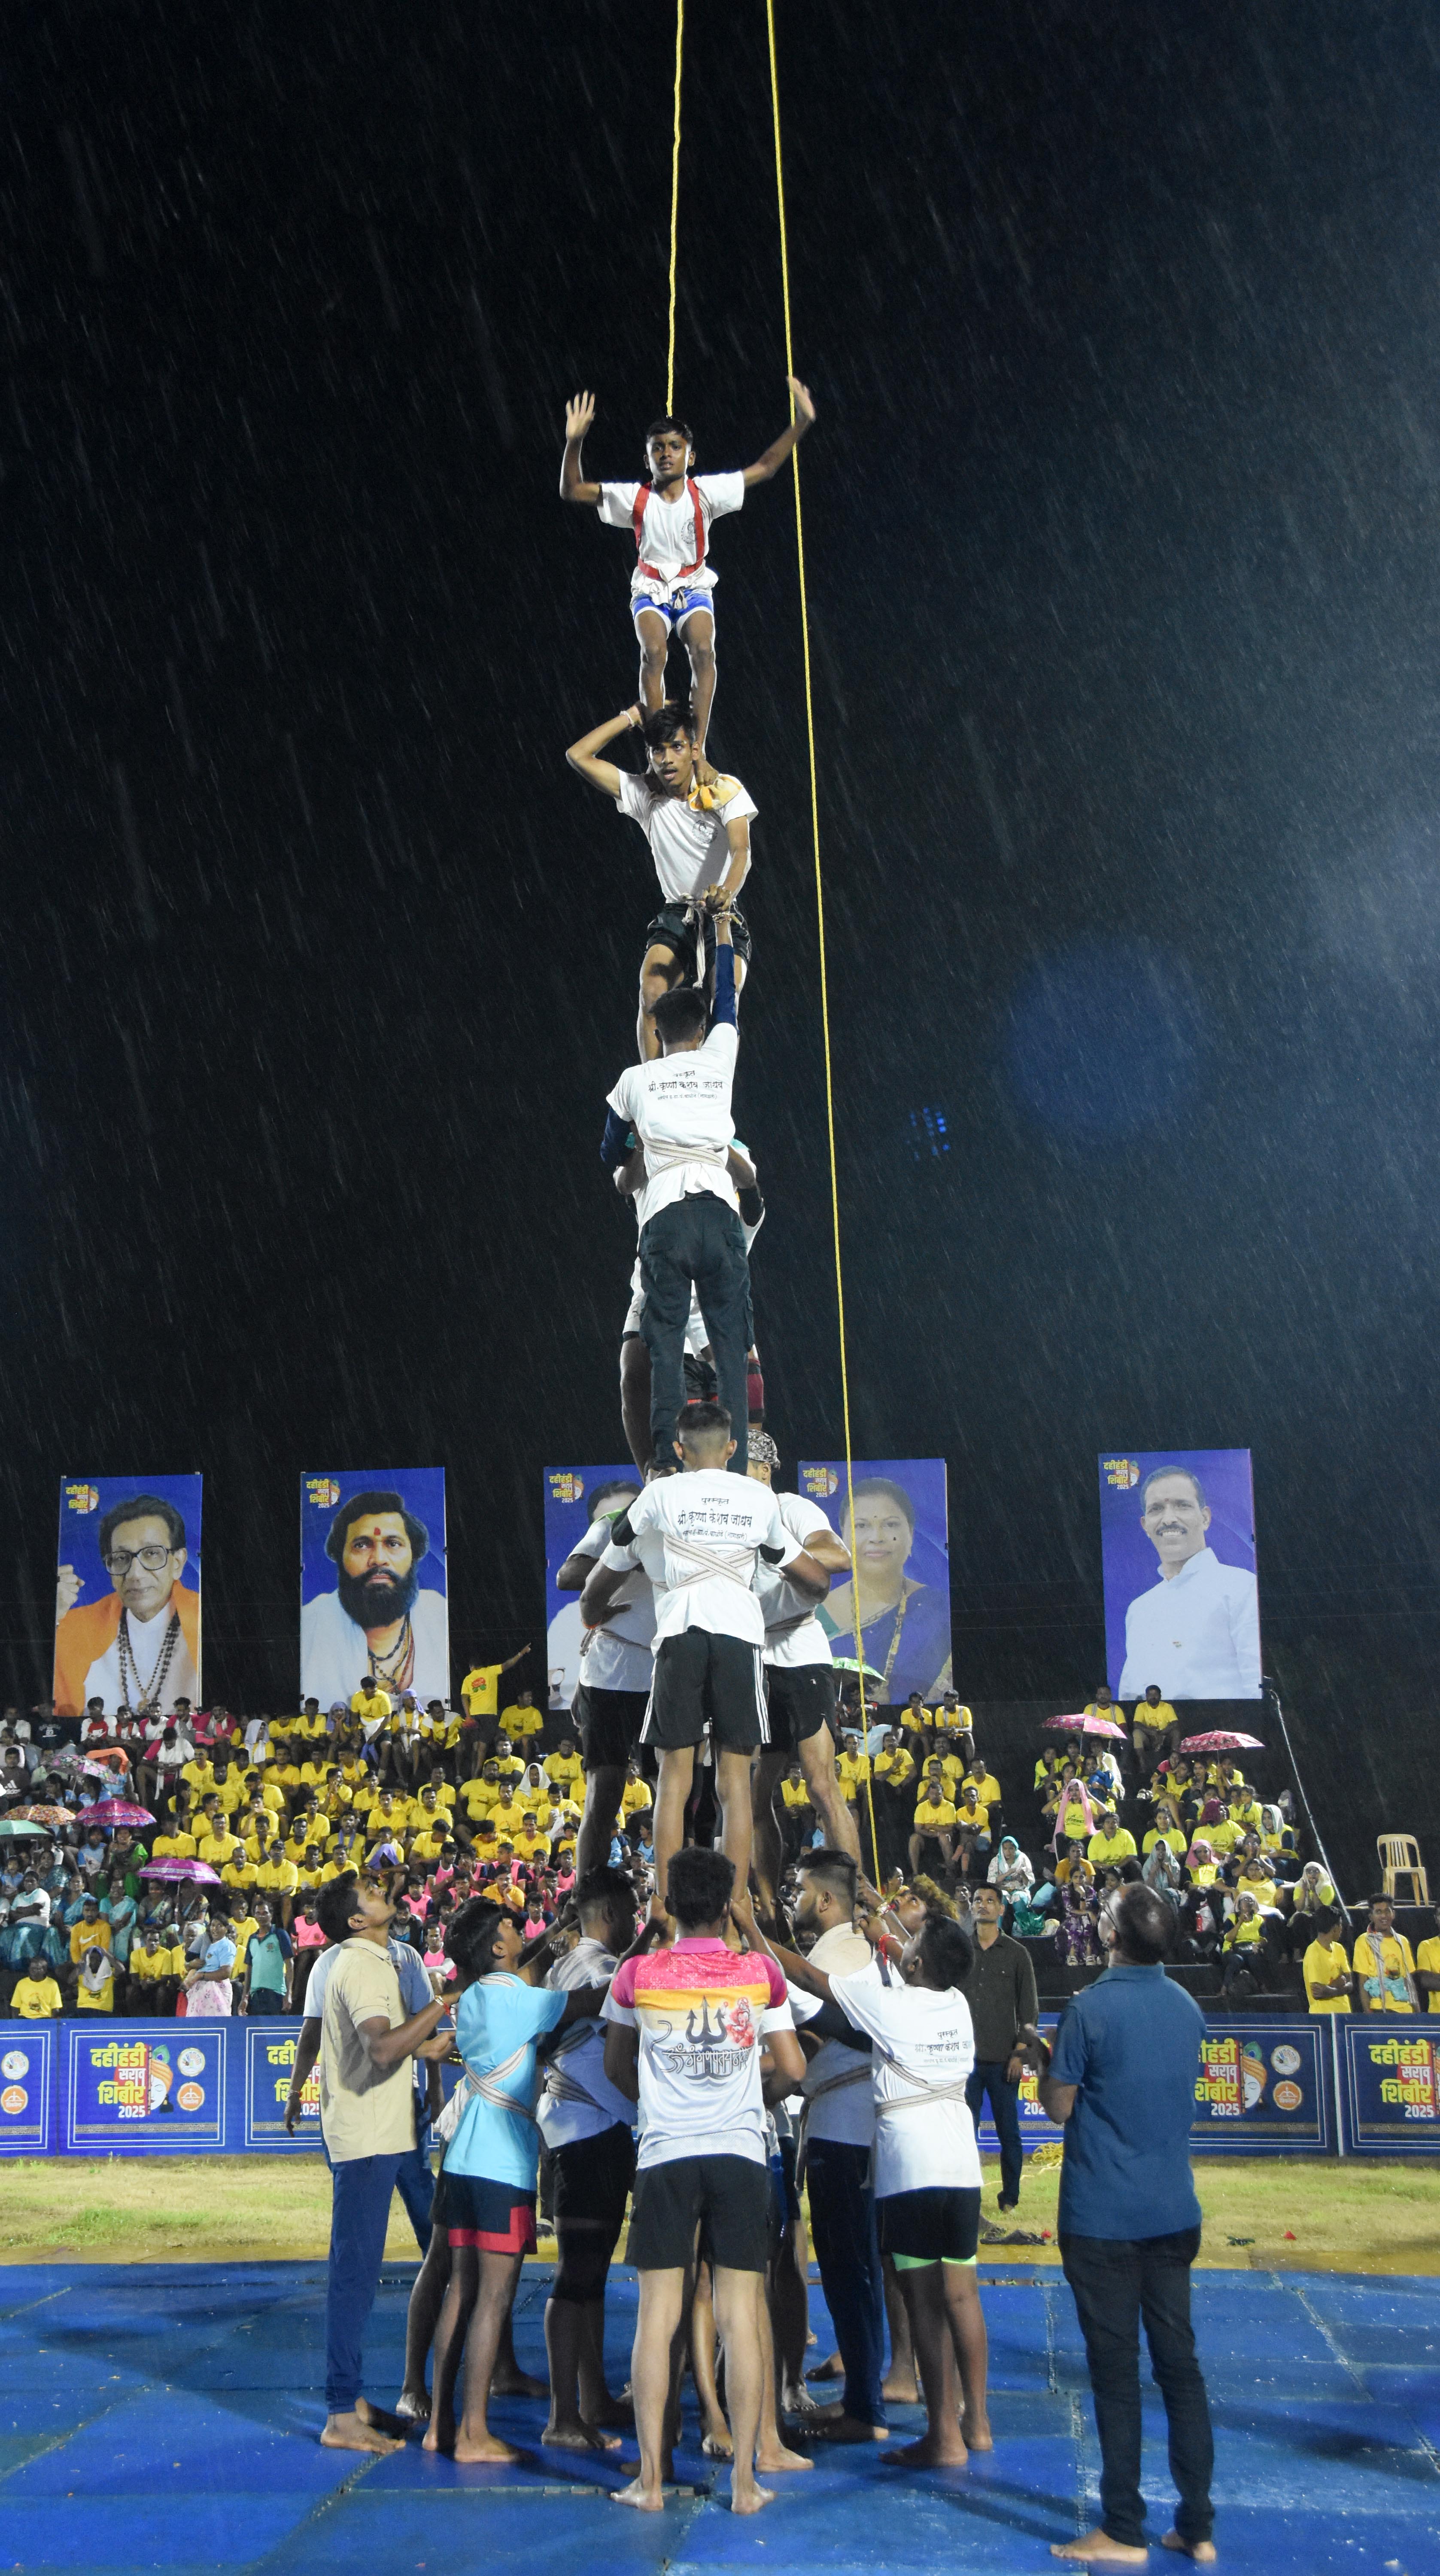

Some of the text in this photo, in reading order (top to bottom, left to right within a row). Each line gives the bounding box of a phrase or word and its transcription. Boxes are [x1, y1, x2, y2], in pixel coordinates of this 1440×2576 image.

[1103, 1459, 1127, 1470] दहीहंडी
[549, 1473, 572, 1483] दहीहंडी
[803, 1467, 826, 1477] दहीहंडी
[306, 1479, 329, 1488] दहीहंडी
[1107, 1475, 1128, 1484] शिबीर
[709, 1508, 729, 1525] केशव
[731, 1515, 752, 1527] जाधव
[937, 2029, 958, 2040] पुरस्कृत
[945, 2040, 959, 2051] केशव
[1368, 2039, 1429, 2064] दहीहंडी
[90, 2042, 146, 2067] दहीहंडी
[118, 2068, 146, 2086] सराव
[1208, 2065, 1237, 2083] सराव
[1401, 2066, 1431, 2085] सराव
[97, 2081, 146, 2104] शिबीर
[1379, 2078, 1432, 2102] शिबीर
[118, 2105, 146, 2118] 2025
[1211, 2103, 1240, 2116] 2025
[1405, 2105, 1434, 2117] 2025
